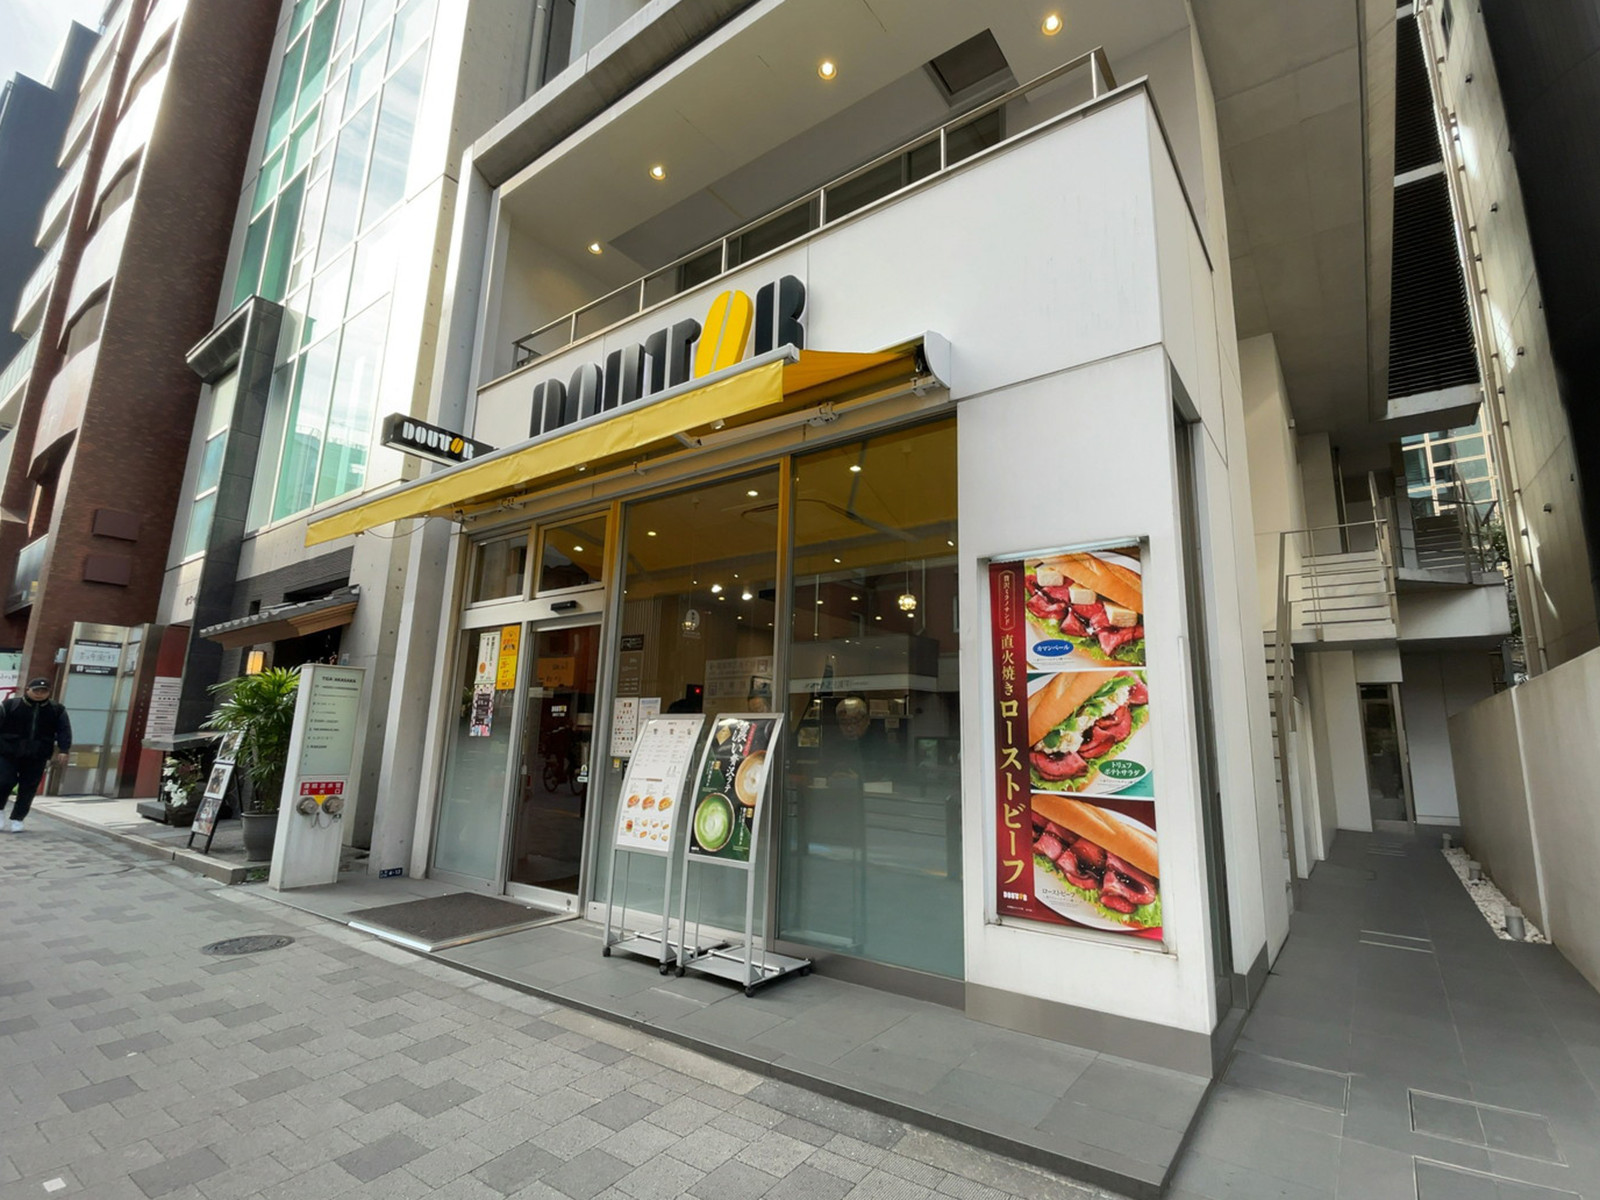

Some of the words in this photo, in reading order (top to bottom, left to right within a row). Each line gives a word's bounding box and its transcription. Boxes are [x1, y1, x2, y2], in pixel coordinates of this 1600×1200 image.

[402, 421, 475, 459] DOUTOR
[1037, 644, 1070, 652] カマンベール
[1104, 768, 1140, 776] ポテトサラダ
[1042, 888, 1076, 898] ローストビーフ
